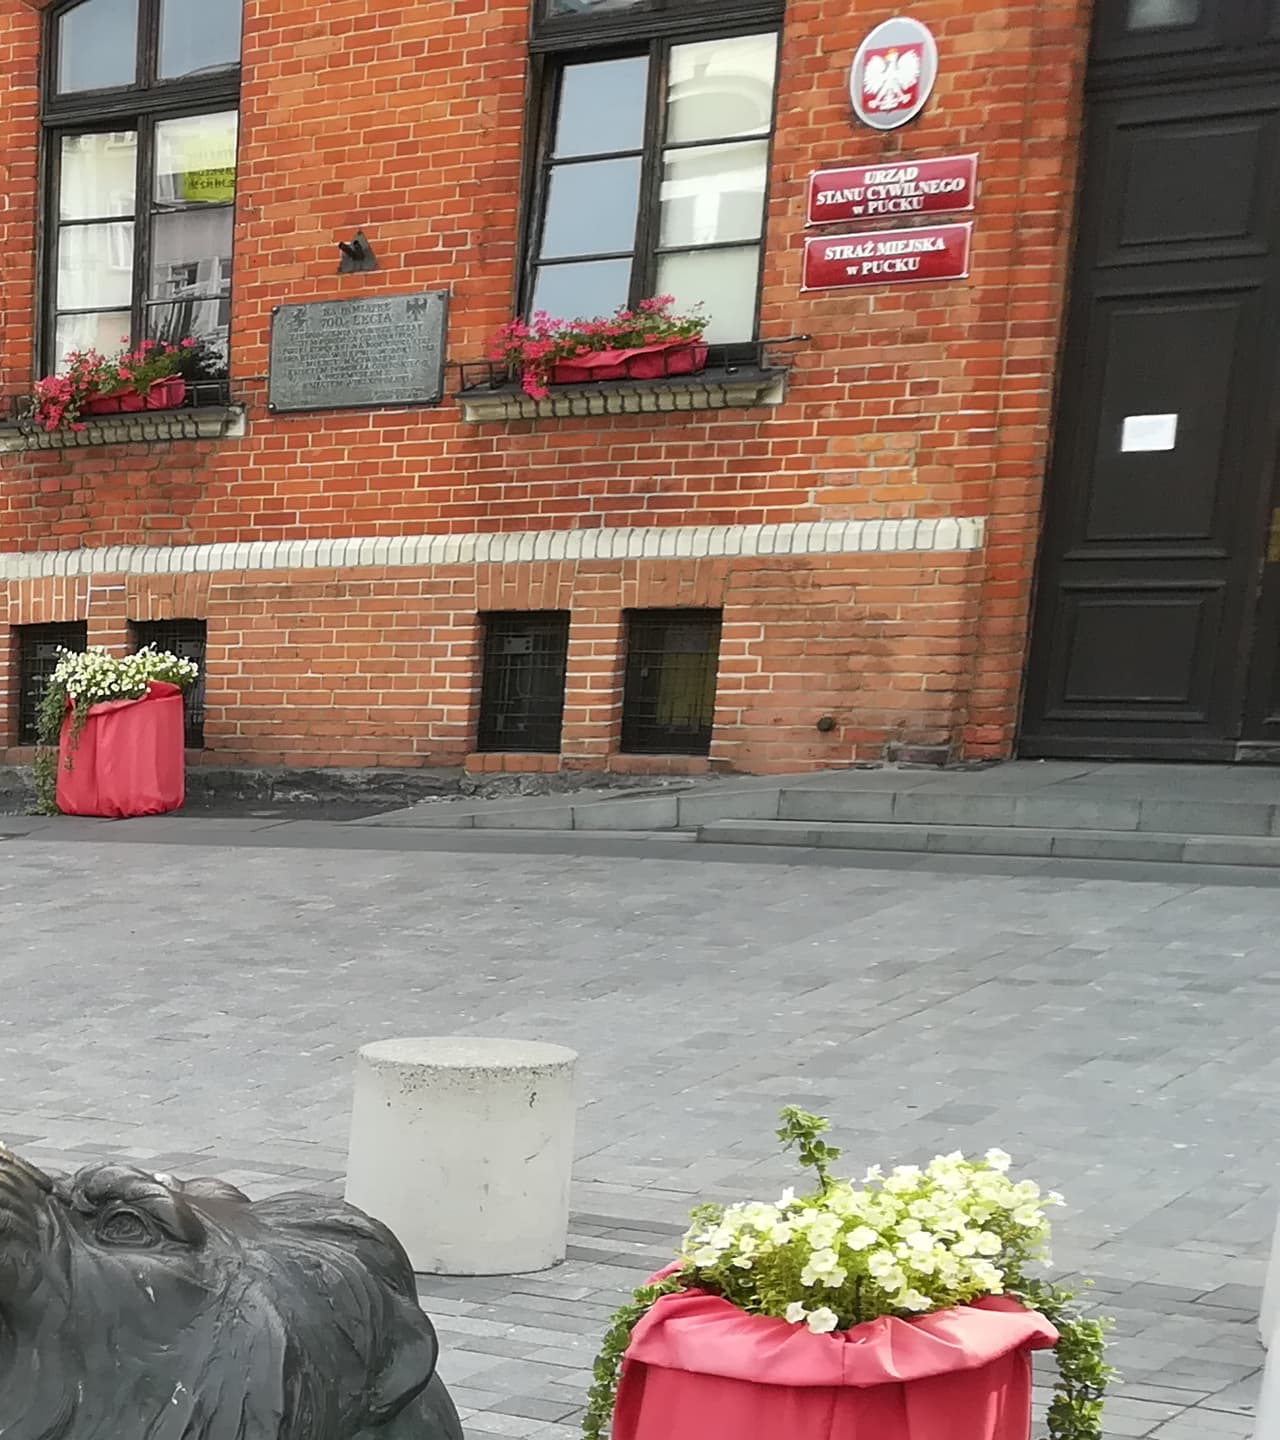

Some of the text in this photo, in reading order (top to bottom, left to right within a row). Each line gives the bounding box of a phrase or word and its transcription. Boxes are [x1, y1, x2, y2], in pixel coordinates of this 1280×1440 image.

[864, 166, 918, 186] URZĄD
[816, 177, 966, 206] STANU CYWILNEGO
[867, 196, 924, 214] PUCKU
[824, 236, 946, 260] STRAŻ MIEJSKA
[861, 257, 920, 275] PUCKU
